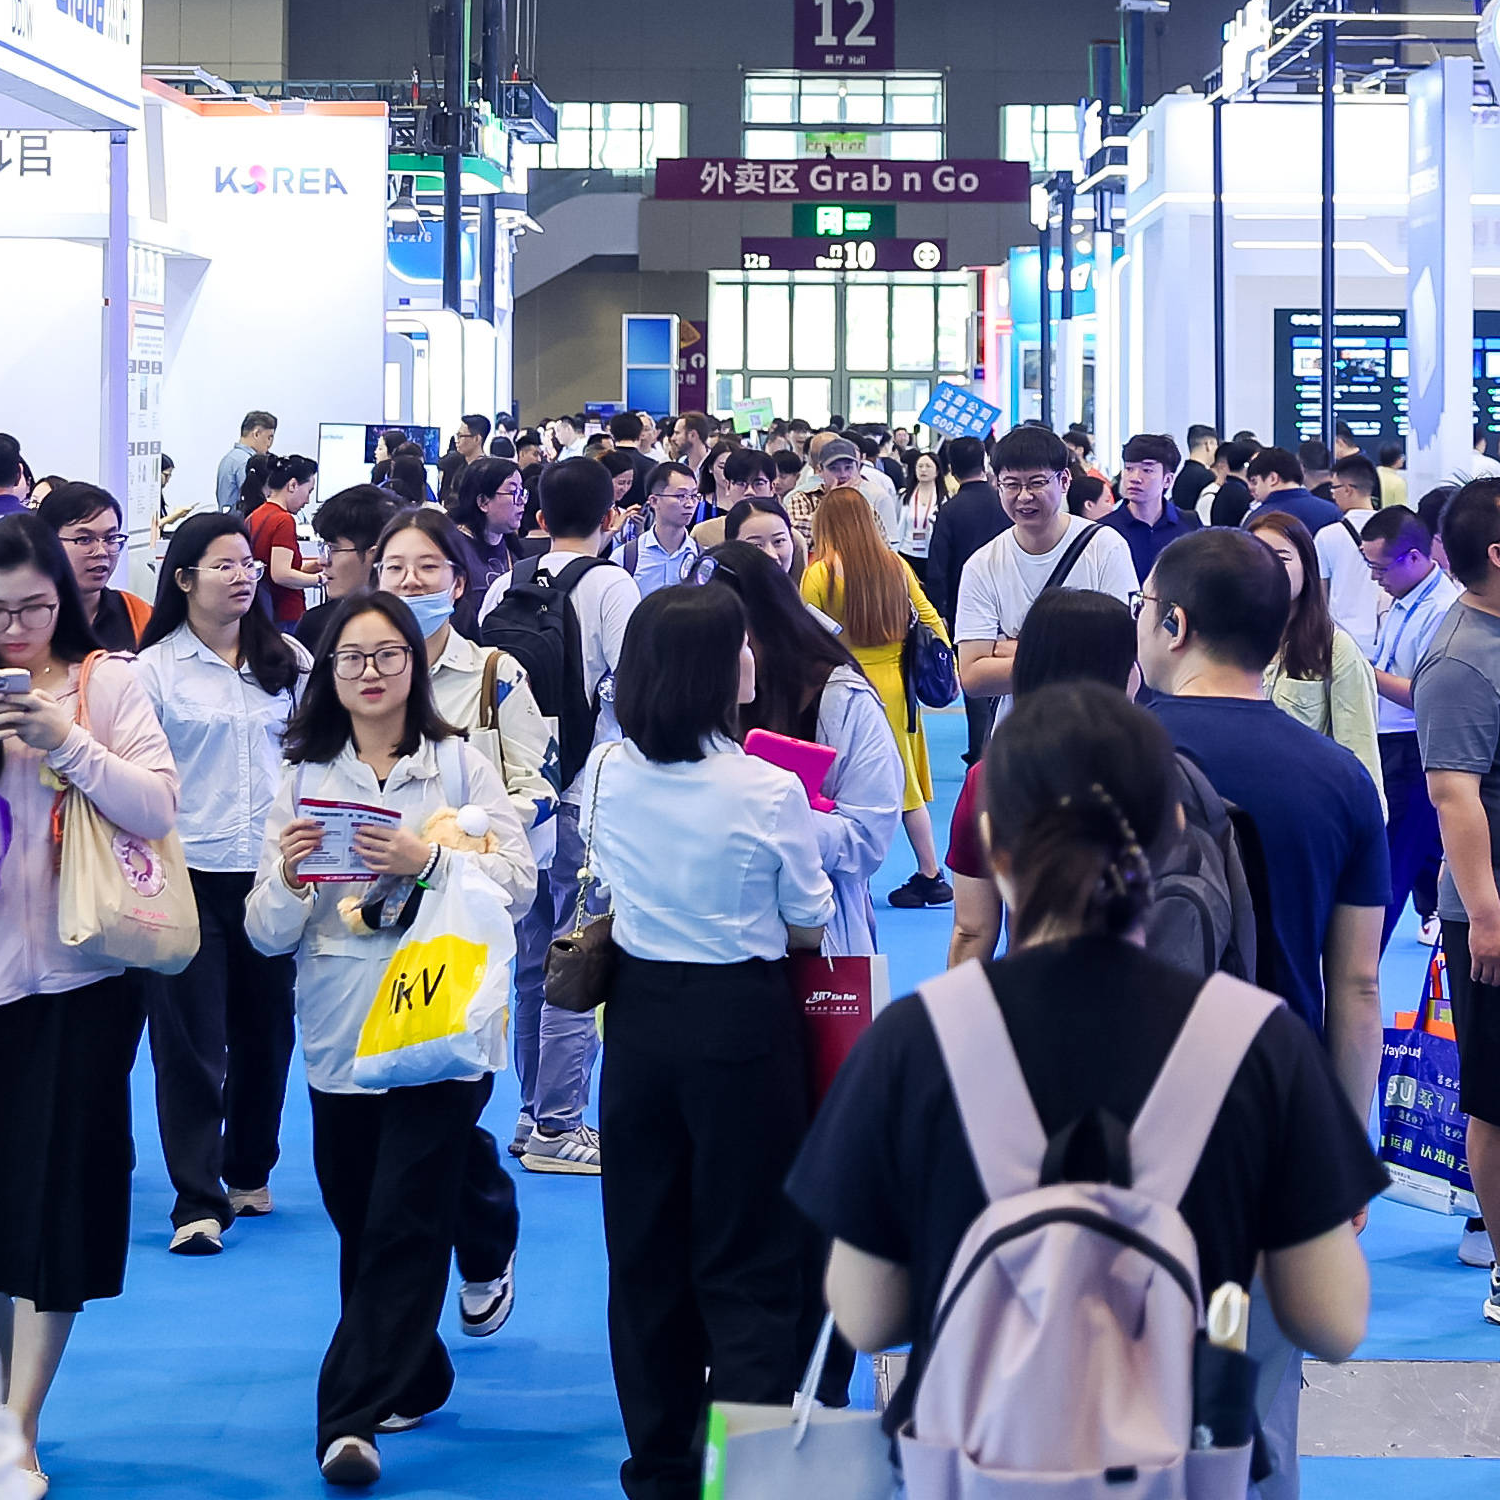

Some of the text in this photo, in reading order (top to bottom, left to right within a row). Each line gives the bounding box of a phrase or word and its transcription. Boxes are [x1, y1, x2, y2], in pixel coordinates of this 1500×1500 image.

[700, 162, 799, 195] 外卖区
[809, 165, 980, 192] Grab n Go
[844, 241, 876, 269] 10
